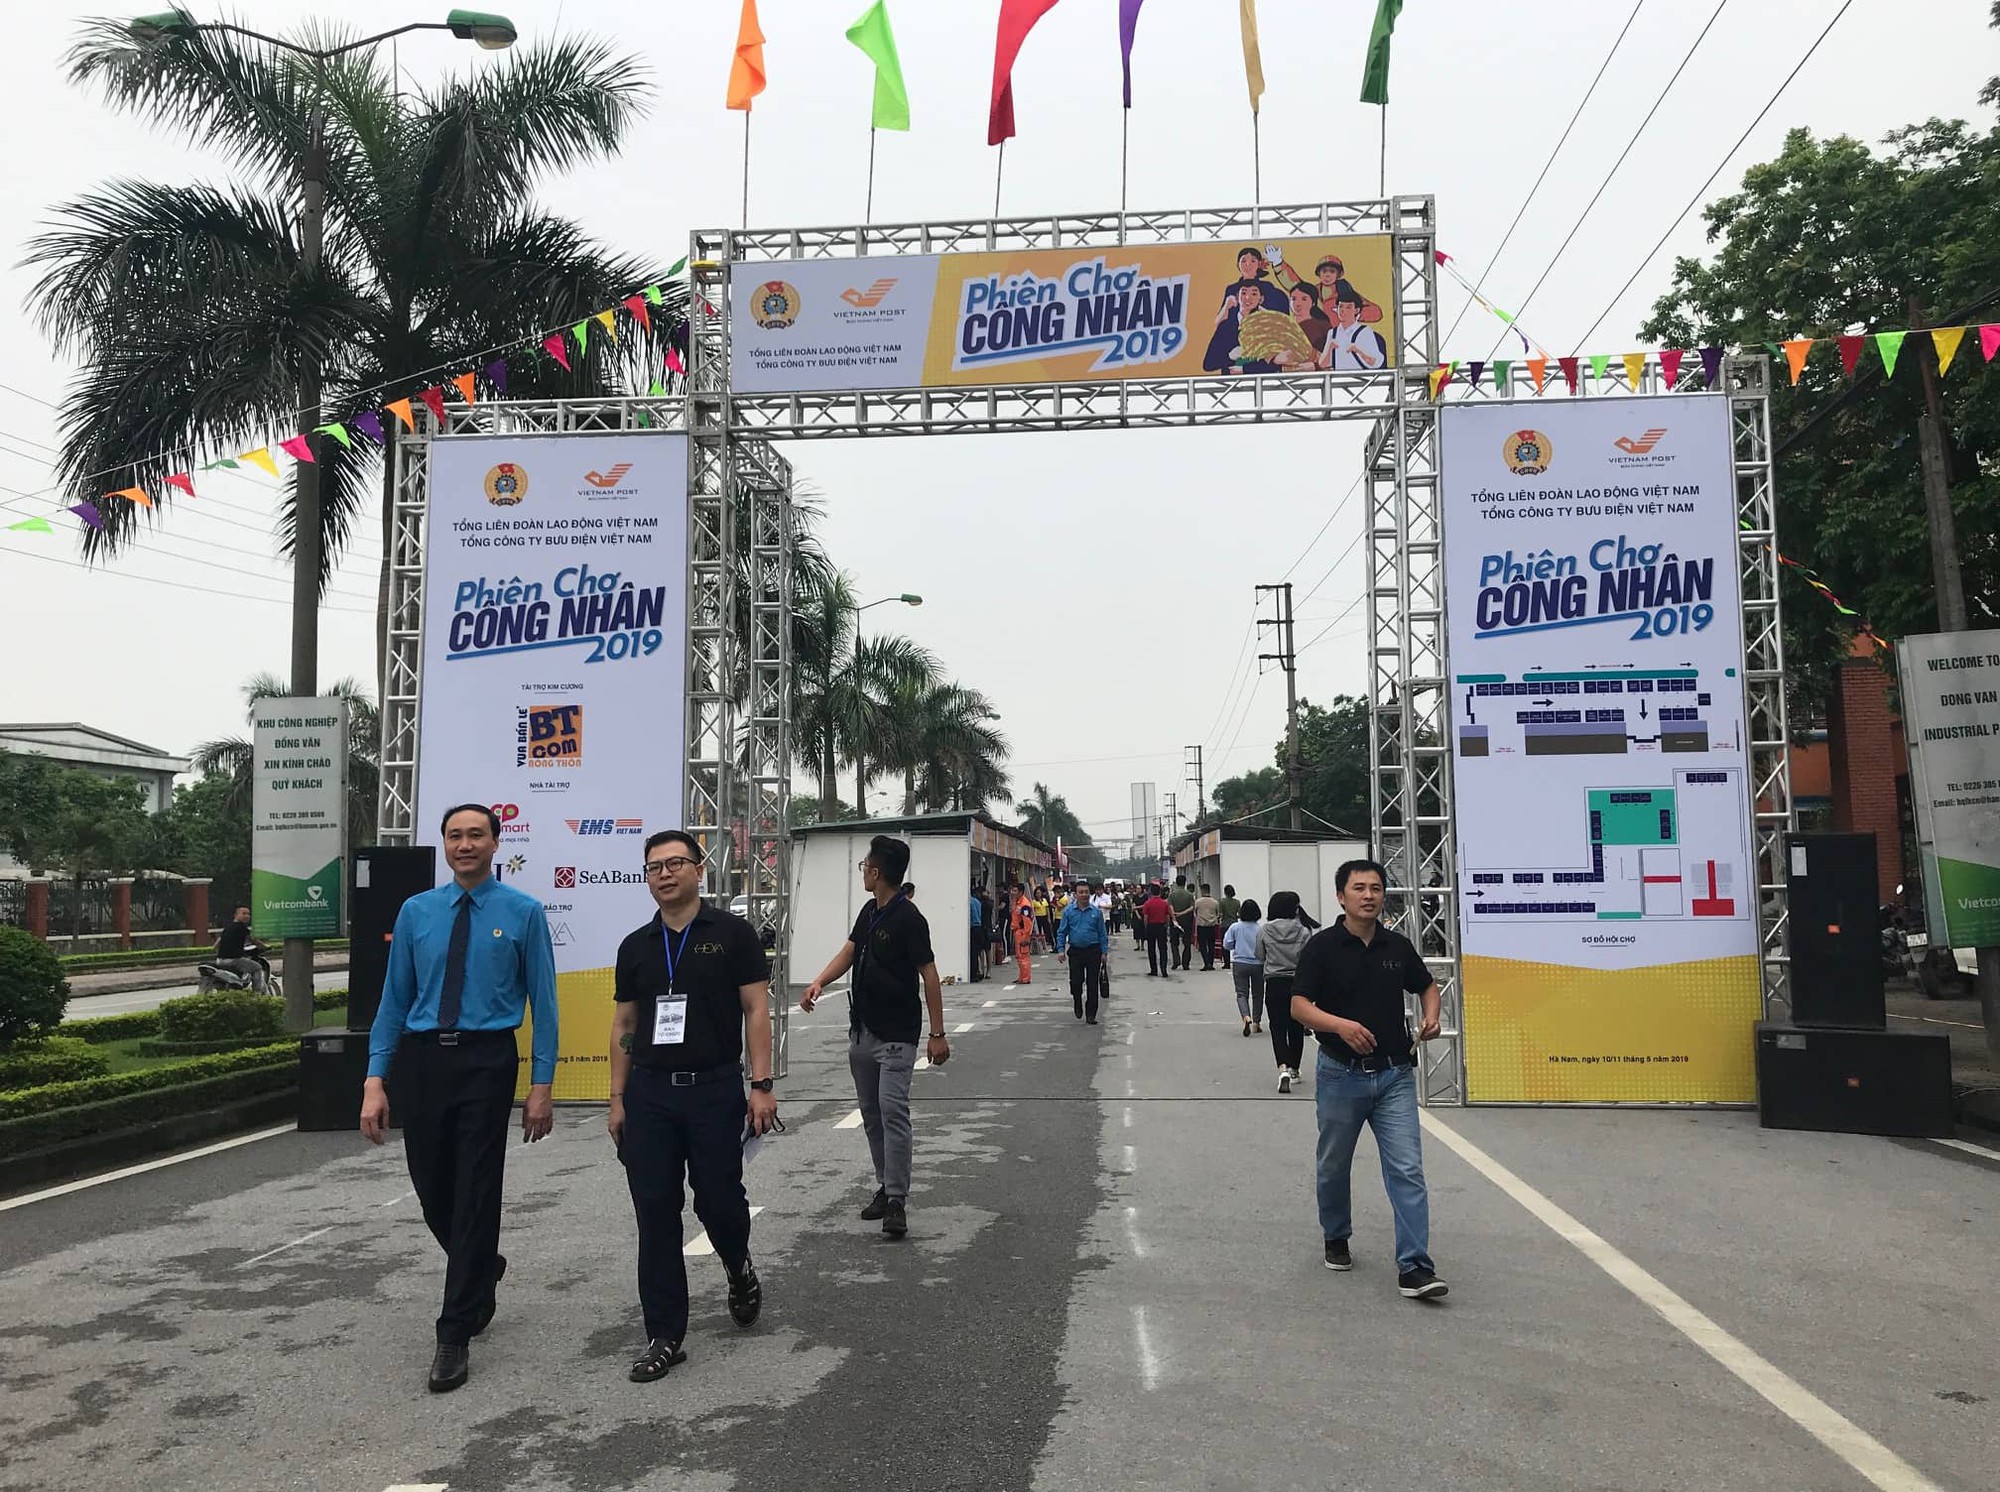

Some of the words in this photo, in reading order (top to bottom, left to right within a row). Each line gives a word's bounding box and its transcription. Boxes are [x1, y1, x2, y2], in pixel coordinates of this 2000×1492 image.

[966, 276, 1057, 314] Phiên
[1068, 262, 1138, 298] Chợ
[833, 310, 876, 318] VIETNAM
[961, 301, 1066, 355] CÔNG
[1074, 279, 1184, 338] NHÂN
[749, 346, 772, 357] TỔNG
[774, 347, 791, 357] LIÊN
[794, 346, 817, 356] ĐOÀN
[819, 347, 836, 355] LAO
[837, 345, 861, 354] ĐỘNG
[863, 344, 881, 353] VIỆT
[883, 344, 901, 352] NAM
[1102, 326, 1182, 363] 2019
[756, 358, 778, 369] TỔNG
[780, 358, 804, 368] CÔNG
[819, 358, 836, 366] BƯU
[838, 357, 857, 367] ĐIỆN
[859, 355, 876, 365] VIỆT
[879, 356, 897, 364] NAM
[1471, 488, 1504, 503] TỔNG
[1508, 489, 1535, 501] LIÊN
[1539, 487, 1573, 500] ĐOÀN
[1576, 489, 1600, 499] LAO
[1603, 486, 1638, 499] ĐỘNG
[1642, 483, 1669, 497] VIỆT
[1672, 485, 1700, 495] NAM
[1481, 505, 1515, 520] TỔNG
[1519, 506, 1554, 519] CÔNG
[1557, 507, 1572, 517] TY
[1576, 504, 1601, 517] BƯU
[1605, 503, 1634, 517] ĐIỆN
[1637, 502, 1664, 516] VIỆT
[1667, 503, 1694, 514] NAM
[453, 517, 482, 531] TỔNG
[485, 519, 509, 531] LIÊN
[513, 518, 544, 530] ĐOÀN
[547, 519, 569, 529] LAO
[571, 517, 603, 530] ĐỘNG
[606, 516, 630, 528] VIỆT
[634, 517, 658, 527] NAM
[460, 534, 490, 547] TỔNG
[494, 535, 525, 547] CÔNG
[528, 536, 542, 545] TY
[545, 534, 568, 545] BƯU
[571, 533, 597, 545] ĐIỆN
[600, 532, 623, 545] VIỆT
[627, 534, 651, 543] NAM
[1479, 548, 1577, 588] Phiên
[1589, 534, 1664, 571] Chợ
[454, 575, 542, 612] Phiên
[554, 563, 621, 600] Chợ
[1475, 574, 1587, 630] CÔNG
[1597, 552, 1714, 614] NHÂN
[448, 599, 550, 652] CÔNG
[558, 582, 666, 638] NHÂN
[1629, 603, 1713, 641] 2019
[583, 629, 663, 664] 2019
[1927, 655, 1984, 671] WELCOME
[1985, 654, 2000, 667] TO
[1940, 692, 1972, 707] DONG
[1974, 691, 1998, 704] VAN
[257, 718, 276, 729] KHU
[278, 716, 303, 728] CÔNG
[305, 715, 338, 729] NGHIỆP
[529, 704, 579, 742] BT
[1924, 724, 1990, 741] INDUSTRIAL
[264, 760, 280, 769] XIN
[500, 822, 530, 833] mart
[578, 819, 614, 835] EMS
[263, 898, 329, 909] Vietcombank
[1560, 1055, 1580, 1063] Nam,
[1581, 1055, 1600, 1064] ngày
[1602, 1055, 1621, 1063] 10/11
[1623, 1055, 1645, 1064] tháng
